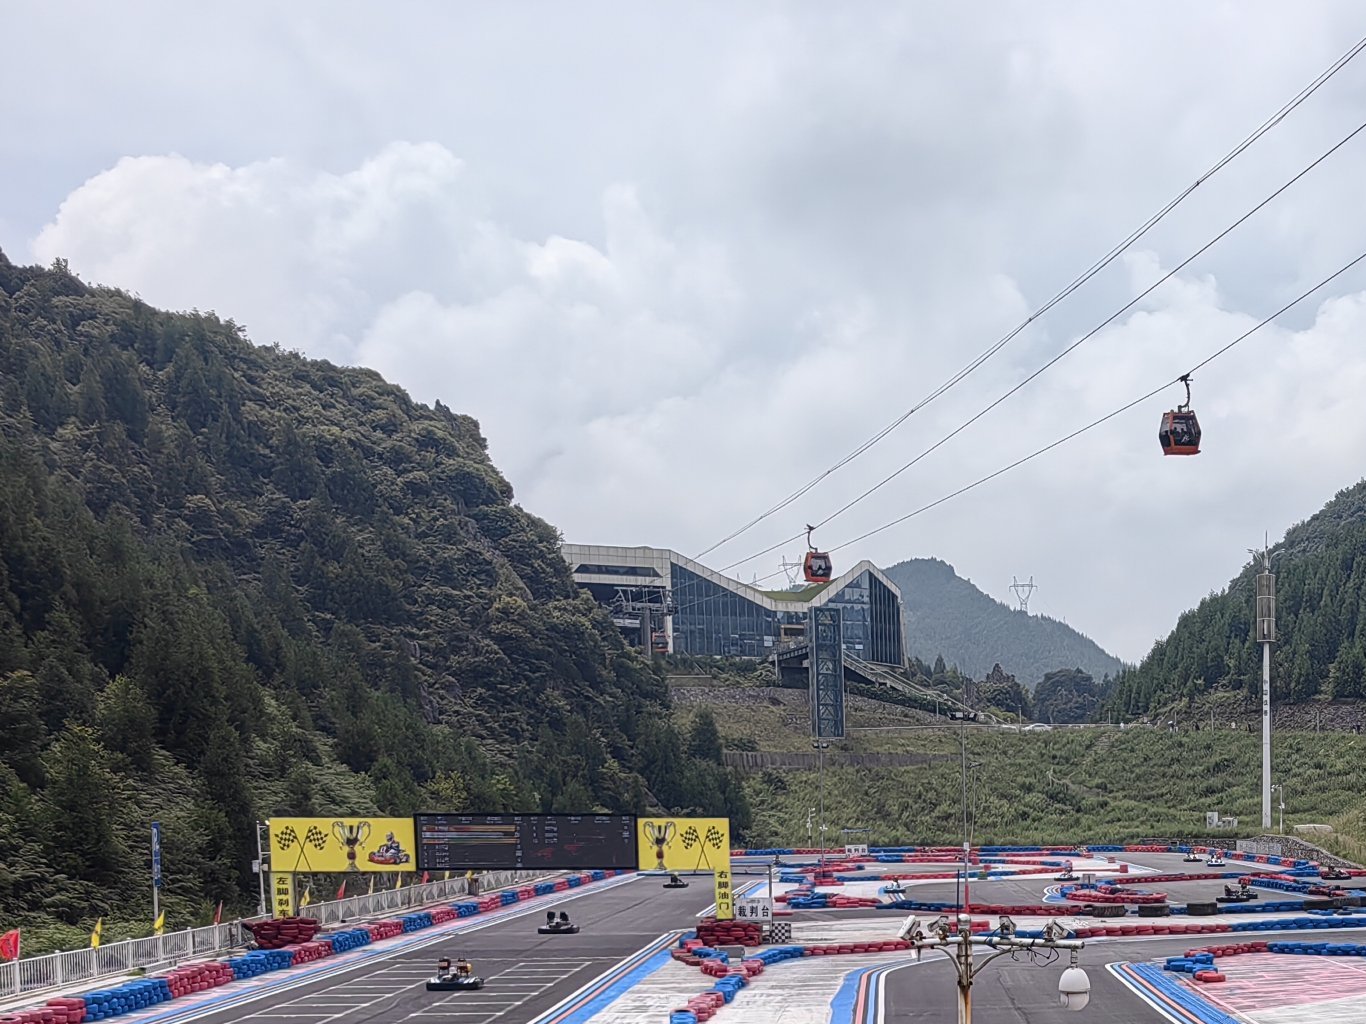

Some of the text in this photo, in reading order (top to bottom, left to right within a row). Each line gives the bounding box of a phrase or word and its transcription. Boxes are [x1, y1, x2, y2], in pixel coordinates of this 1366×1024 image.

[717, 870, 730, 911] 右脚油门
[737, 905, 770, 918] 裁判台
